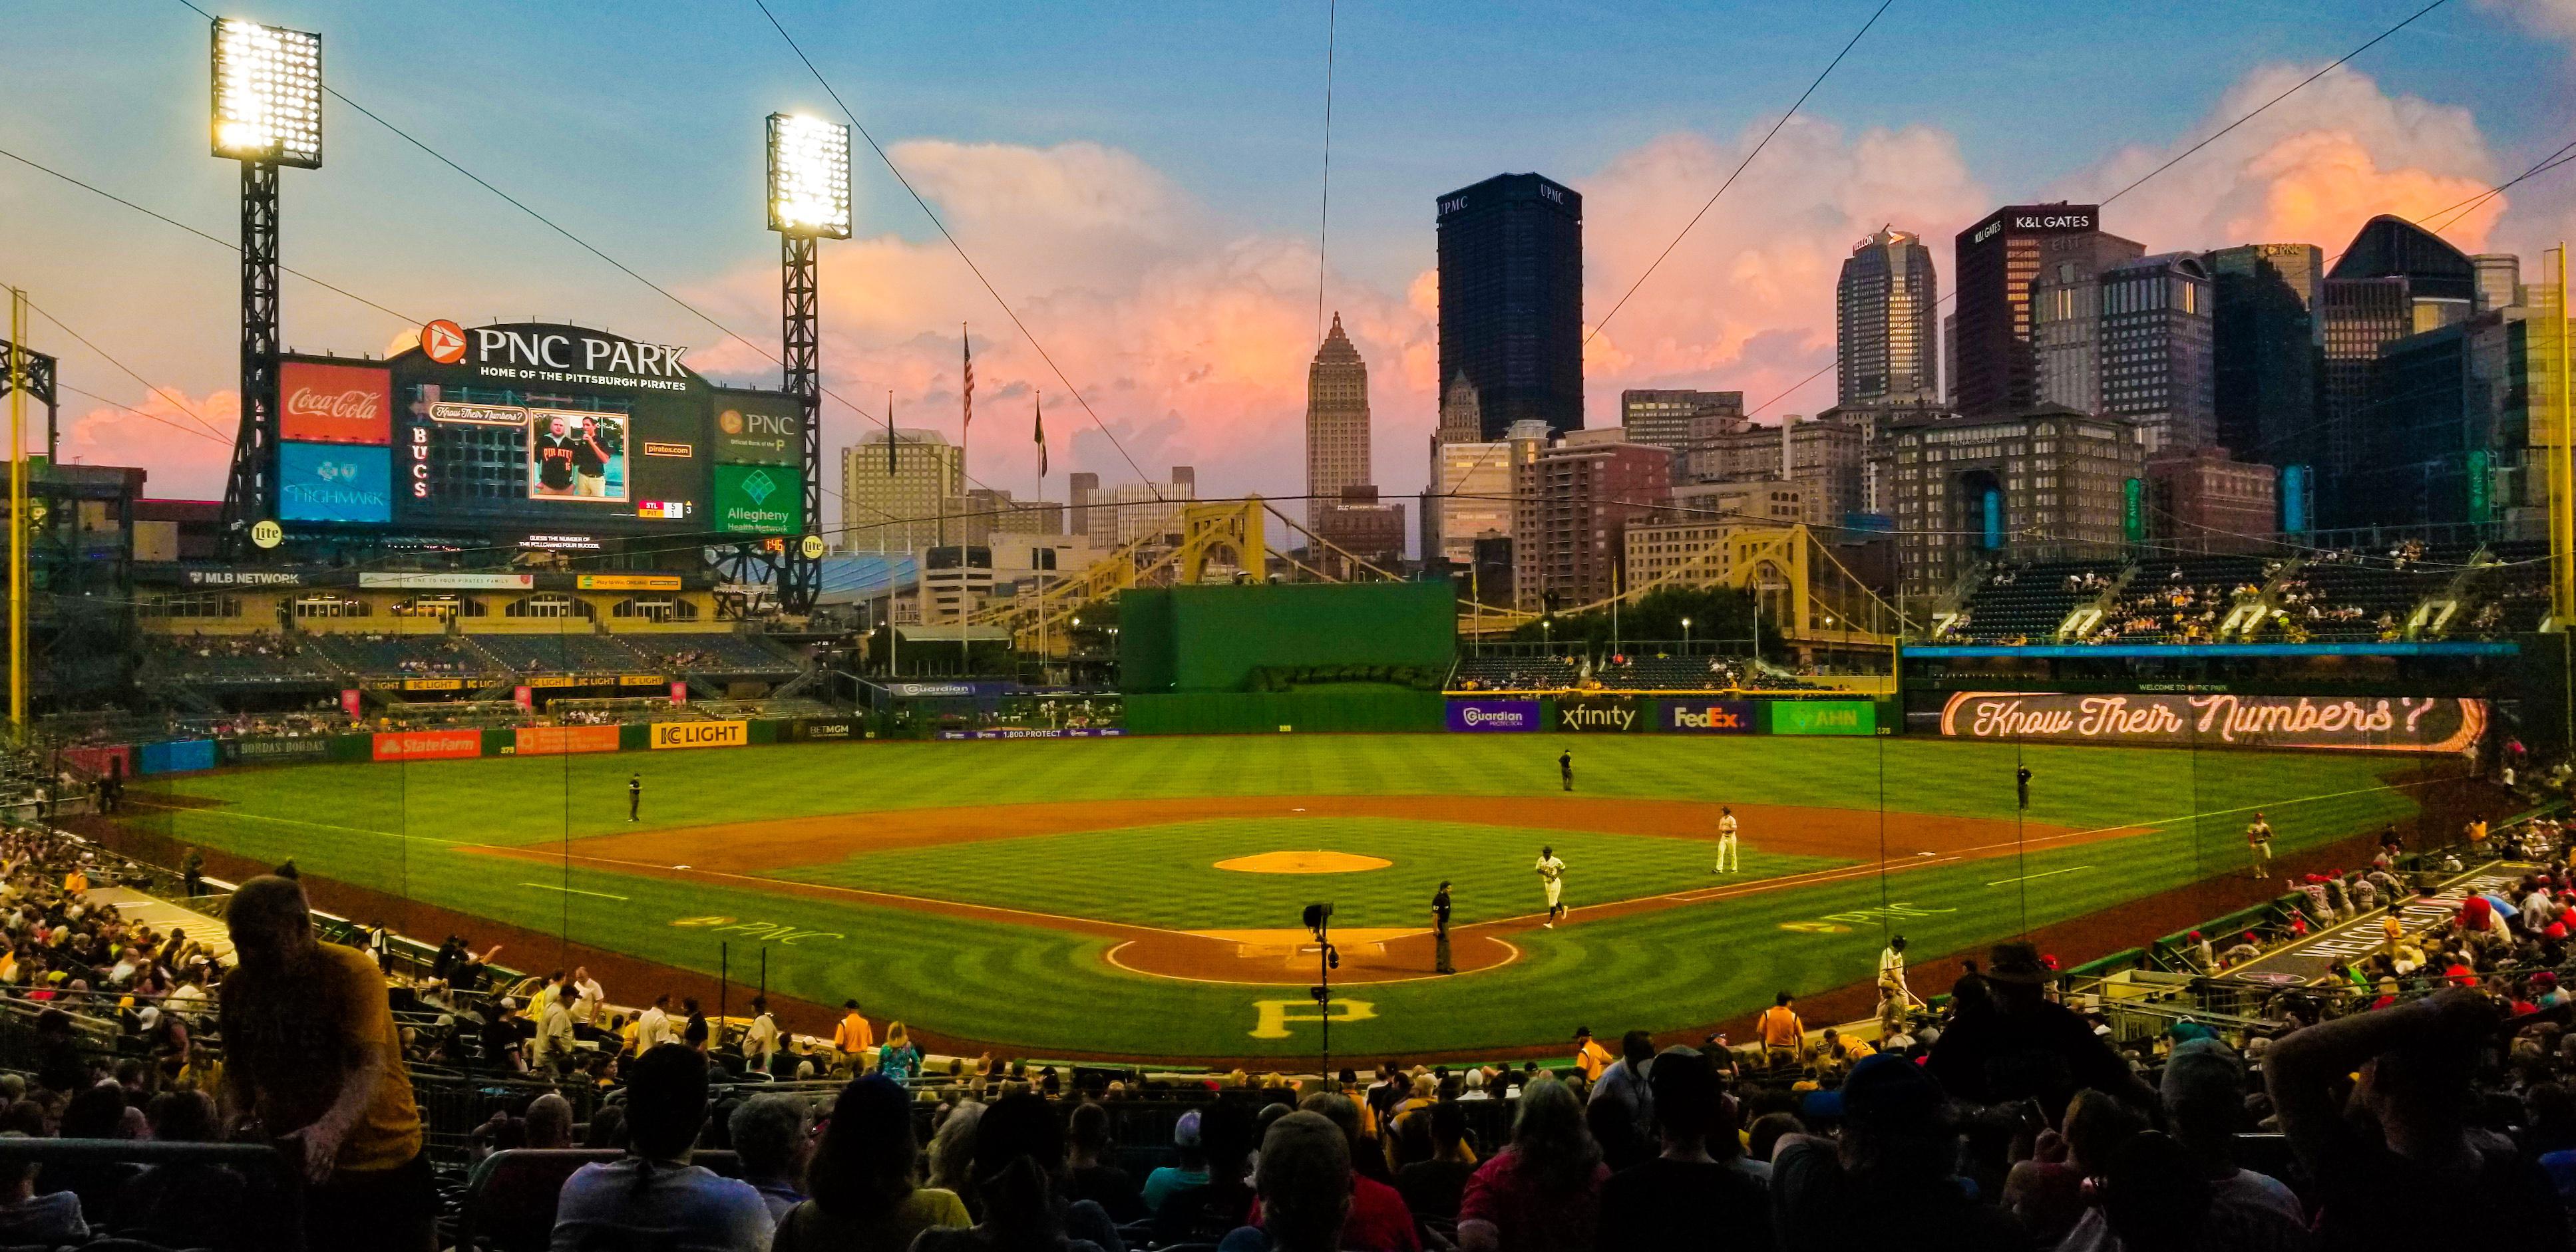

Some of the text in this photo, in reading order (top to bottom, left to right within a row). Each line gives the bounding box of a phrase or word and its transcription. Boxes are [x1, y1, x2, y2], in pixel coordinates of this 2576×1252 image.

[1541, 184, 1564, 205] UPMC
[1437, 196, 1468, 216] UPMC
[2016, 216, 2089, 228] K&L GATES
[1975, 221, 2001, 243] K&L GATES
[1854, 234, 1875, 250] ELLON
[475, 329, 688, 378] PNC PARK
[480, 367, 686, 391] HOME OF THE PITTSBURGH PIRATES
[437, 406, 523, 421] Know Their Numbers?
[746, 414, 795, 435] PNC
[1950, 437, 2000, 446] RENAISSANCE
[413, 427, 427, 497] BUCS
[284, 484, 384, 507] HIGHMARK
[727, 508, 789, 523] Allegheny
[254, 526, 279, 542] Lite
[805, 542, 821, 553] Lite
[206, 573, 299, 584] MLB NETWORK
[903, 684, 969, 695] Guardian
[1463, 707, 1523, 726] Guardian
[1563, 703, 1636, 730] xfinity
[1674, 706, 1739, 727] FedEx
[1815, 709, 1857, 726] AHN
[1974, 701, 2073, 737] Know
[2079, 697, 2183, 736] Their
[685, 726, 739, 742] LIGHT
[810, 724, 848, 734] BETMGM
[1247, 998, 1379, 1038] P
